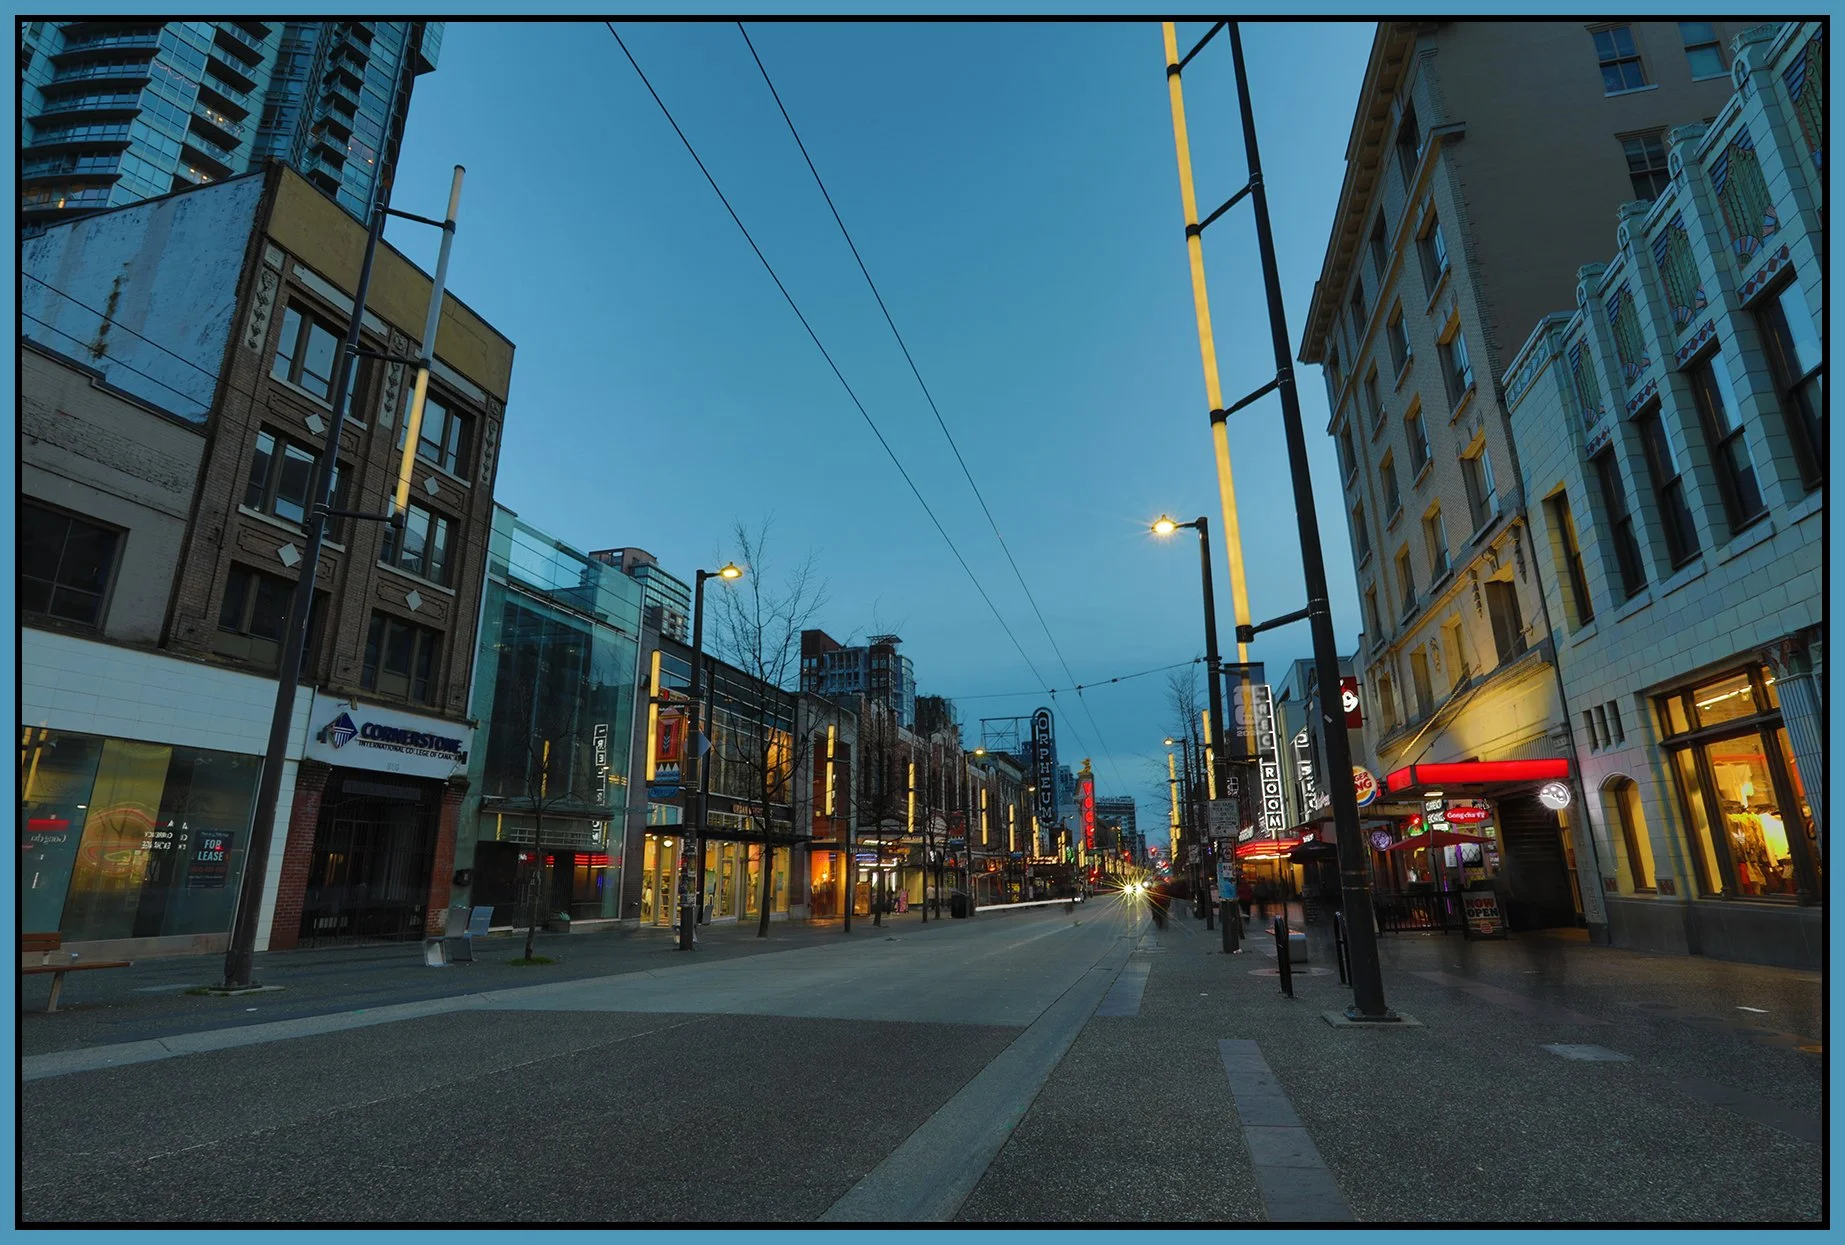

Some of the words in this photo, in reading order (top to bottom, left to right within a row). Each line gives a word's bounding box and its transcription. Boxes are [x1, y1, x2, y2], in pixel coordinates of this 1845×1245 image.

[361, 722, 463, 753] CORNERSTONE
[358, 740, 404, 753] INTERNATIONAL
[438, 752, 458, 761] CANAA
[1038, 717, 1052, 818] ORPHEUM
[1353, 771, 1368, 783] GER
[1354, 779, 1372, 793] NG
[1265, 767, 1281, 827] ROOM
[204, 839, 222, 849] FOR
[198, 851, 224, 861] LEASE
[1464, 898, 1494, 908] NOW
[1467, 908, 1498, 917] OPEN
